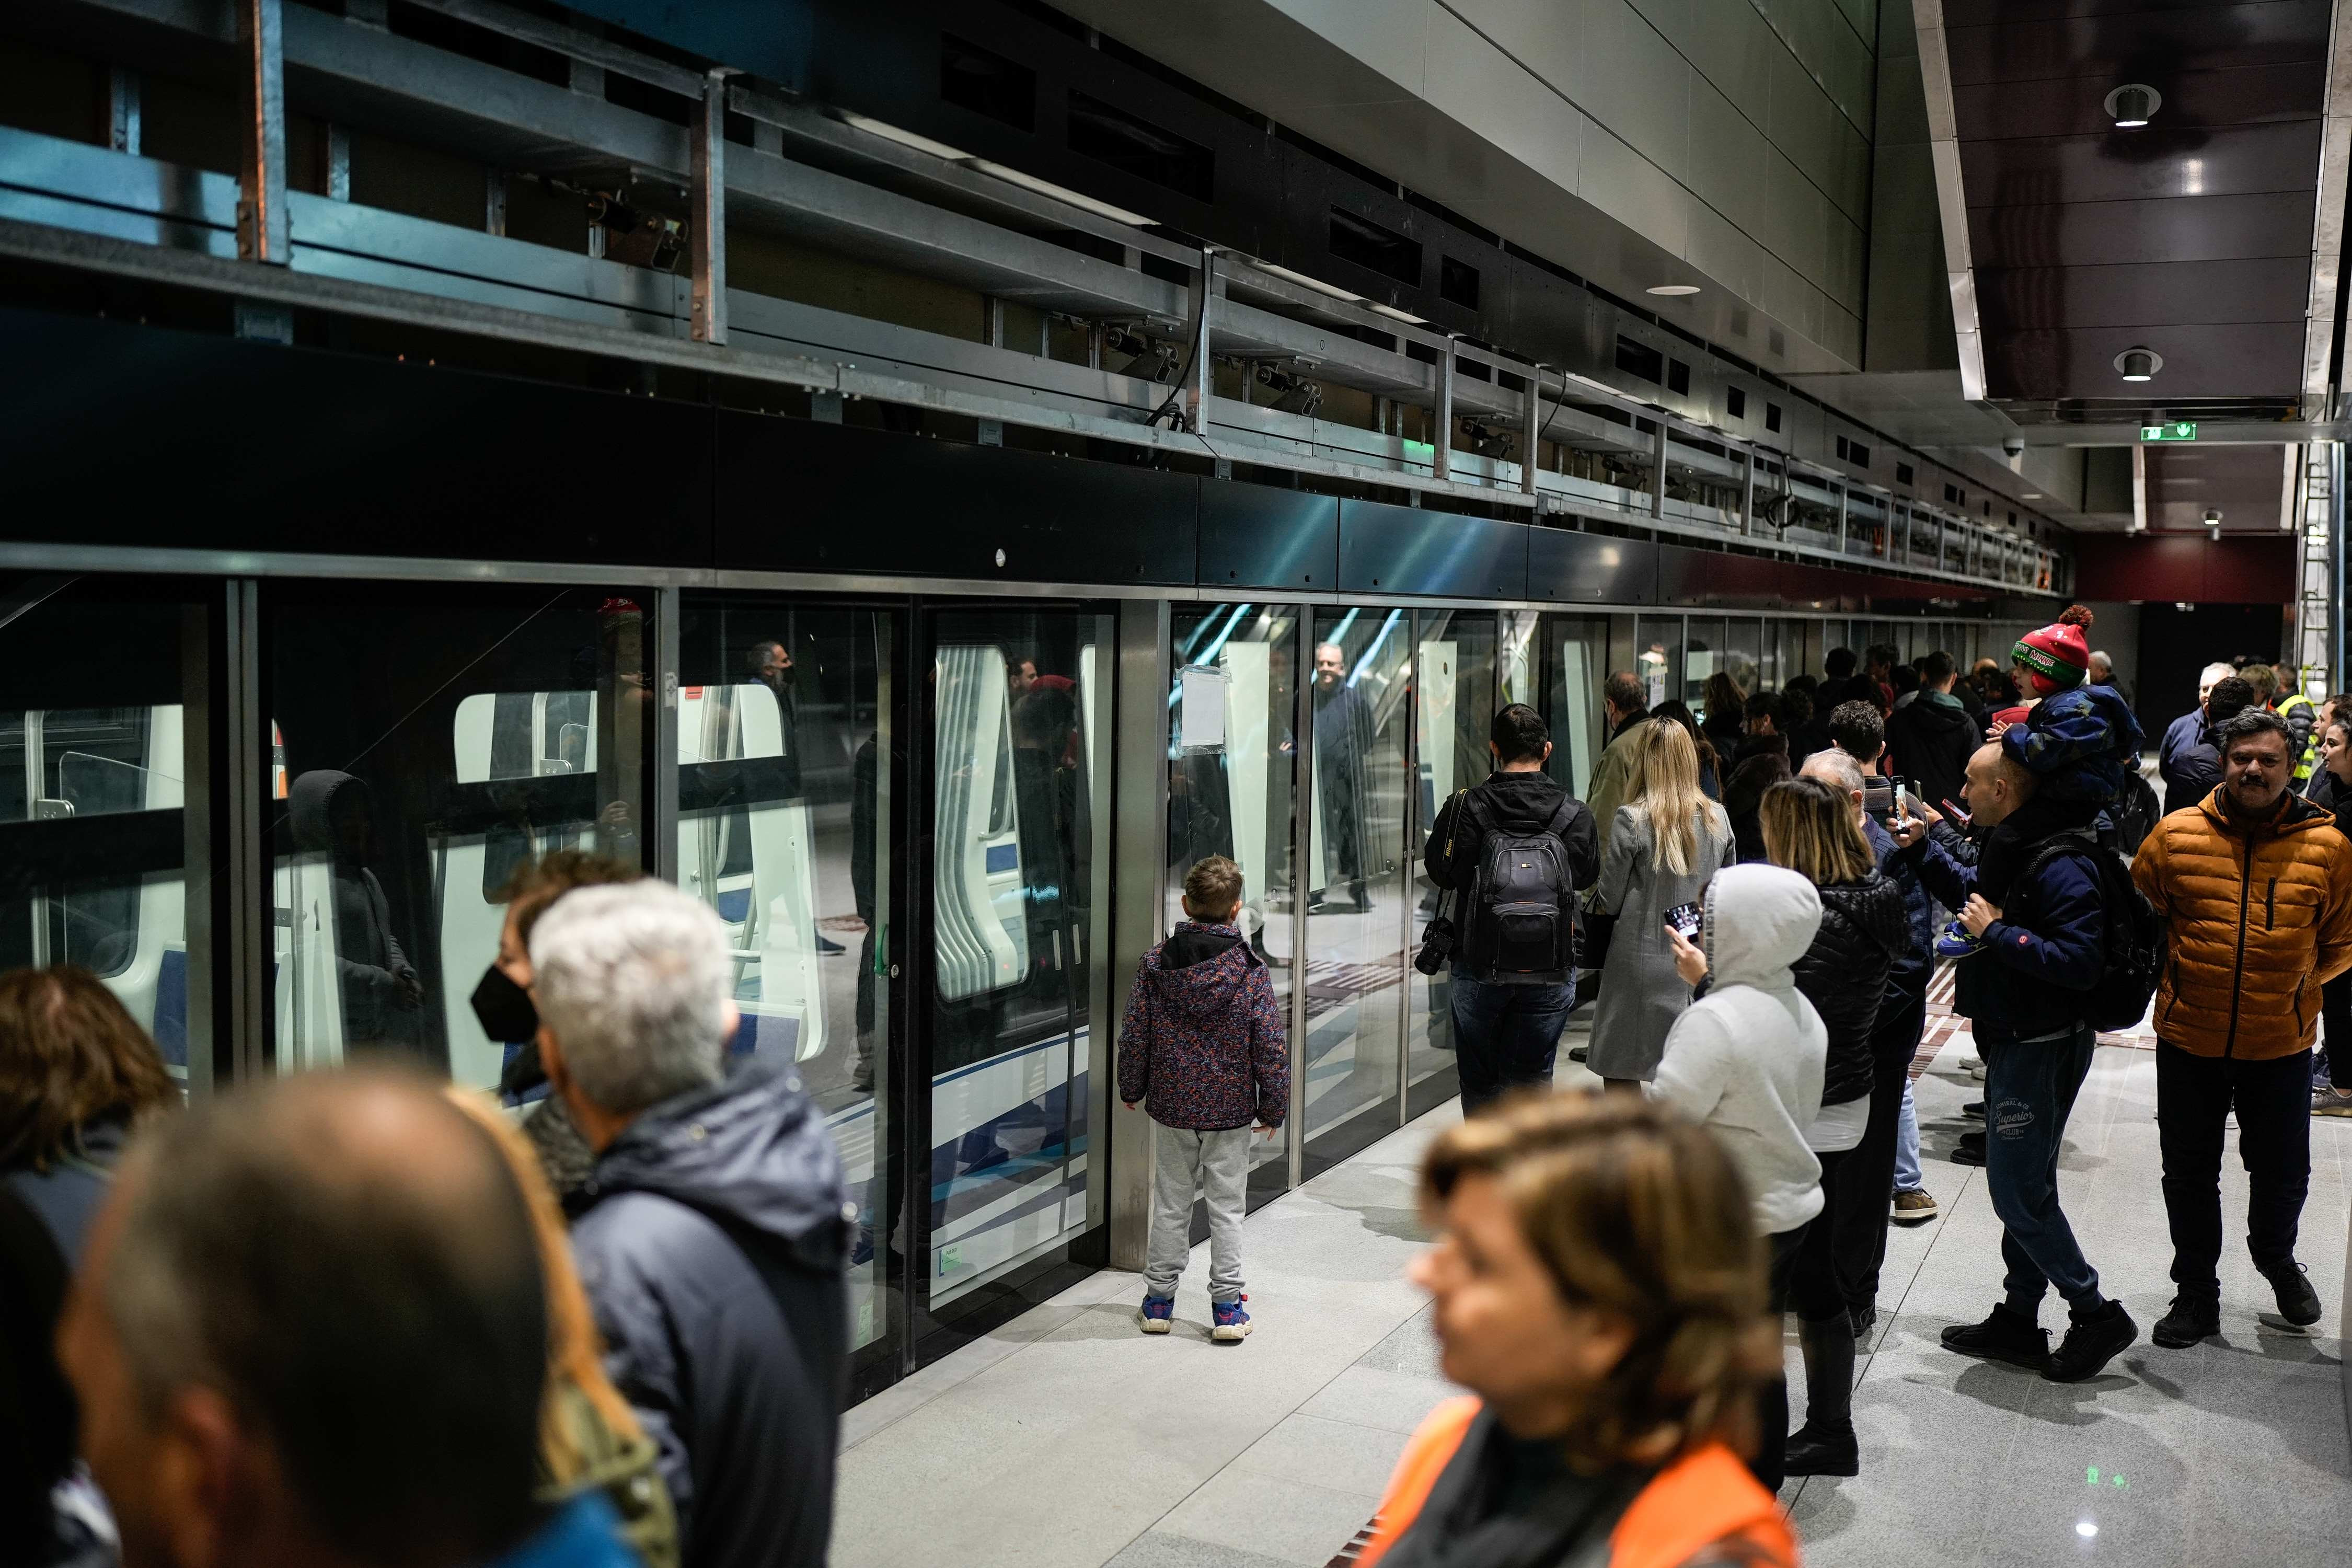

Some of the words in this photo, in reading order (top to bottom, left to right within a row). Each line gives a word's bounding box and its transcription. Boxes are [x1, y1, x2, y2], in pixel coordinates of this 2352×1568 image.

[2029, 650, 2055, 667] MINNIE
[1445, 839, 1453, 857] Nikon
[1994, 1110, 2035, 1125] Superior
